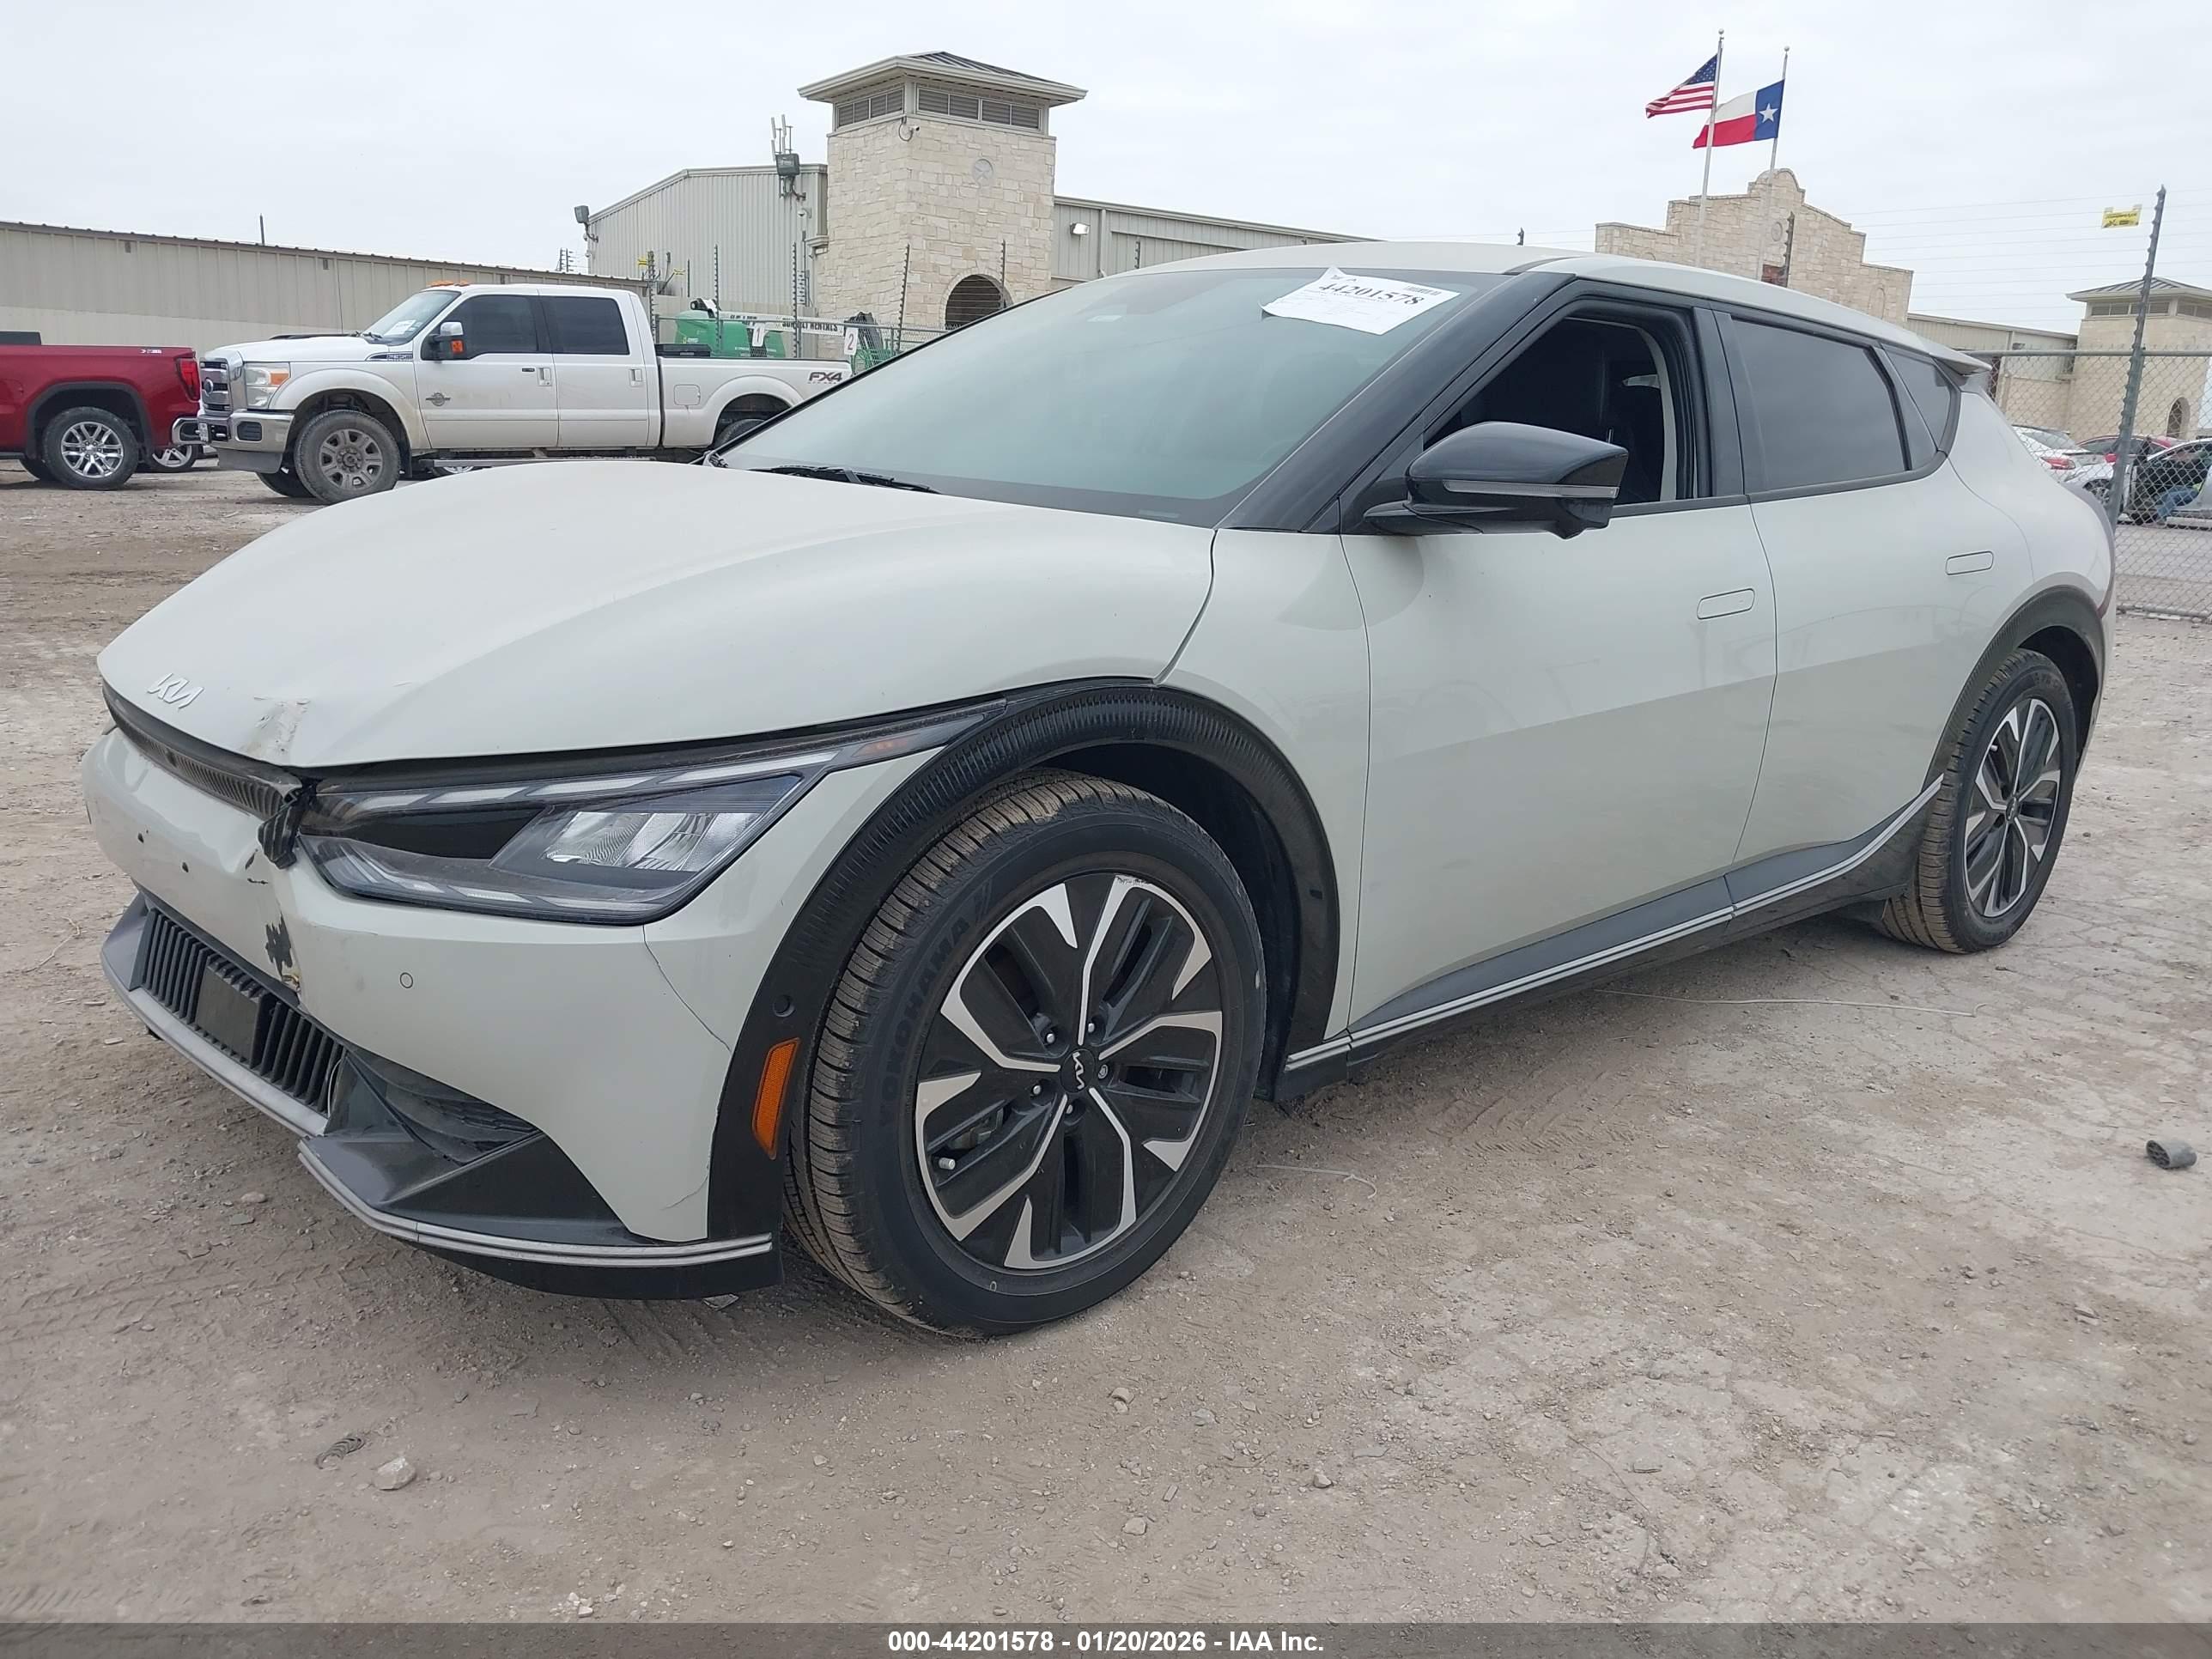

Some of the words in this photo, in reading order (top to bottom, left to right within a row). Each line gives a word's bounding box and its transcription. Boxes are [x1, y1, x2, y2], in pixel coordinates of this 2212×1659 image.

[1319, 283, 1425, 305] 44201578
[847, 333, 854, 350] 2
[809, 372, 842, 381] FX4
